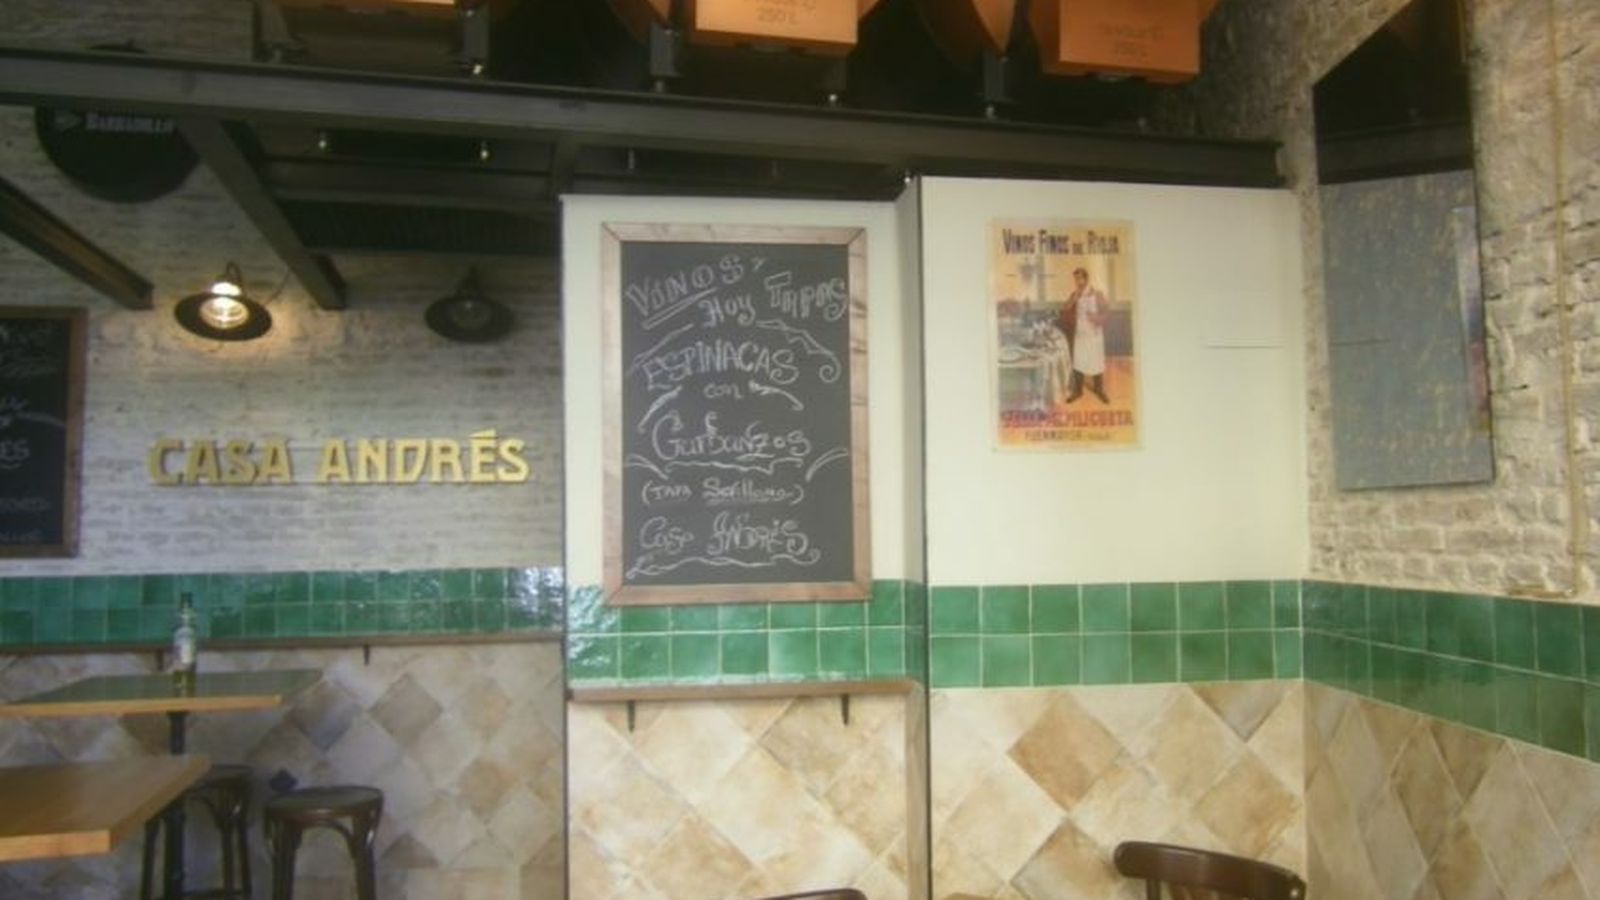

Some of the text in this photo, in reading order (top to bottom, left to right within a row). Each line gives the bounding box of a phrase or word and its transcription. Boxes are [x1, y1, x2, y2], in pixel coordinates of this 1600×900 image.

[642, 338, 799, 390] ESPINACAS
[148, 429, 530, 486] CASA ANDRÉS
